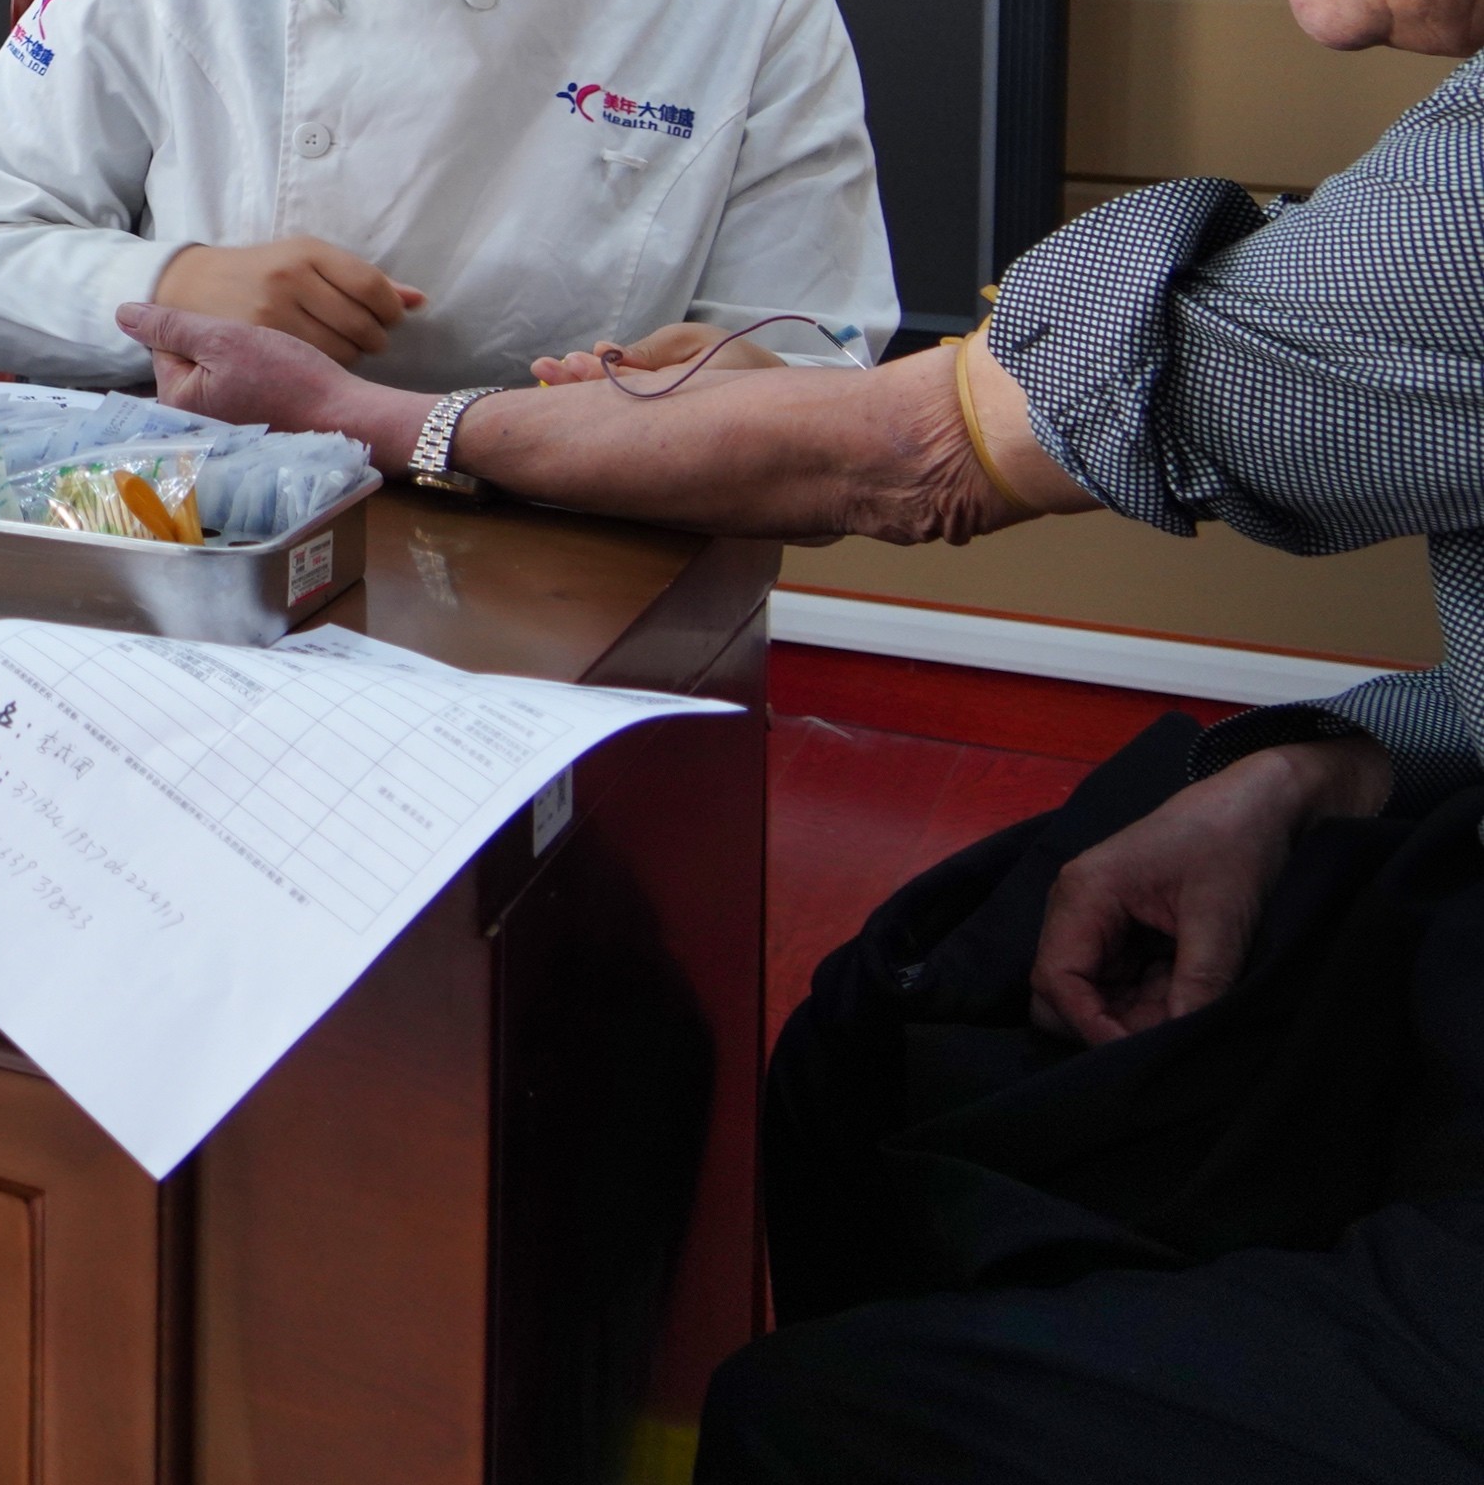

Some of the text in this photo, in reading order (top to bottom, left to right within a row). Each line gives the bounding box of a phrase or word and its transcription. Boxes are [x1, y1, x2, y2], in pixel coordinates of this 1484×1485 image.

[602, 110, 692, 140] Health 100
[603, 92, 696, 128] 美年大健康
